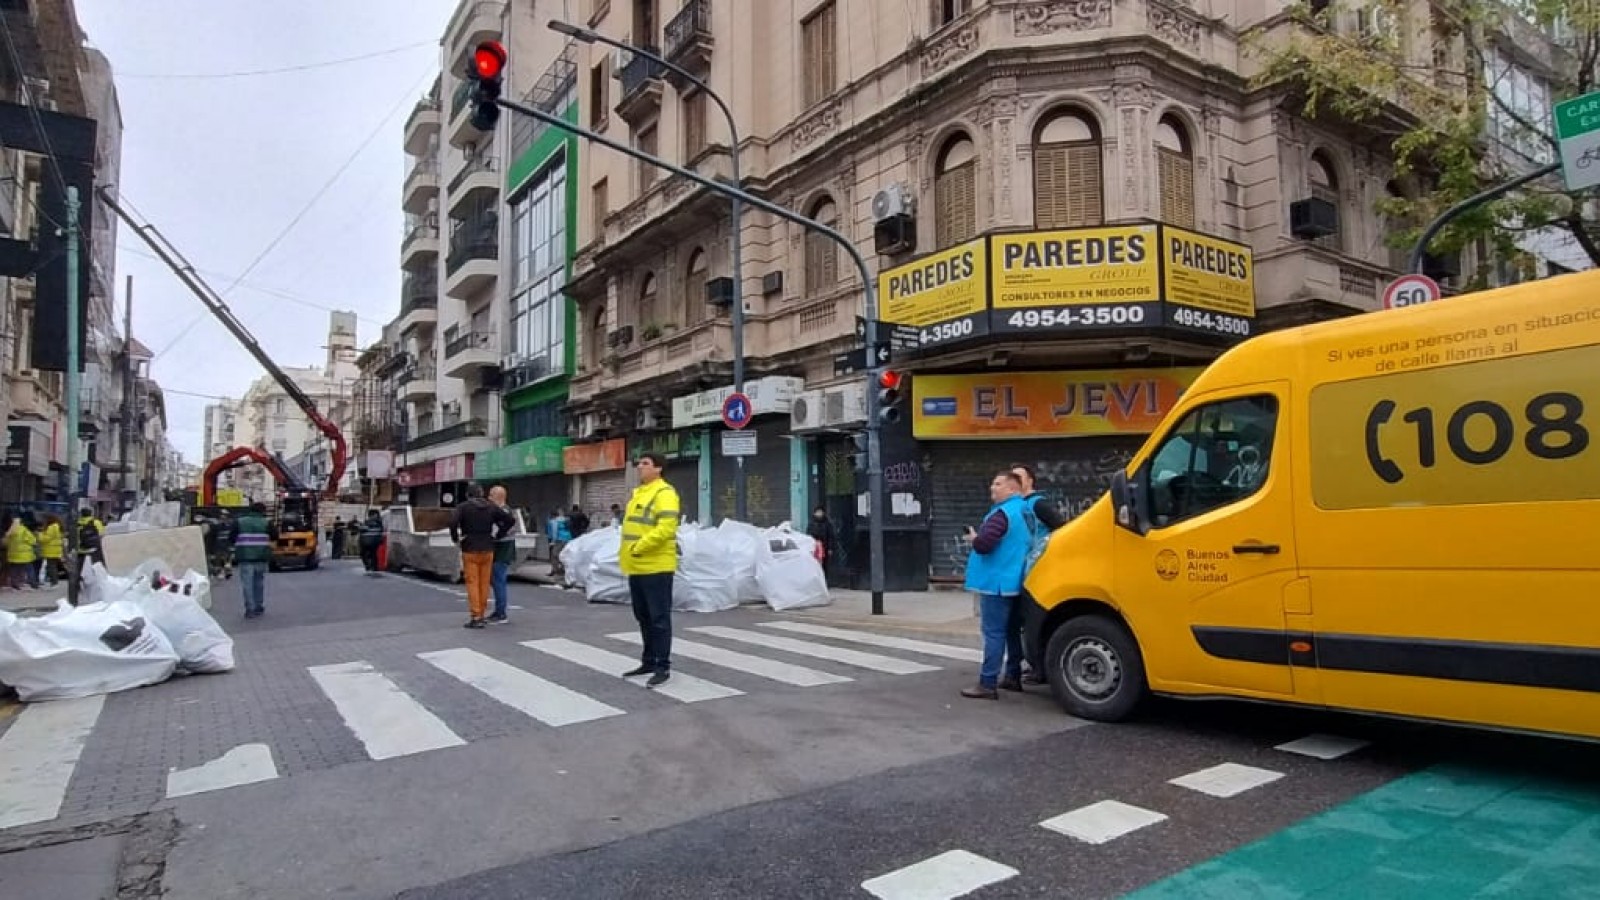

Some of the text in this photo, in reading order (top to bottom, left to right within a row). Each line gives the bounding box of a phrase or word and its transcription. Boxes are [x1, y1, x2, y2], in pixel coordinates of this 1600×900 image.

[1003, 234, 1146, 270] PAREDES
[1171, 237, 1247, 280] PAREDES
[887, 251, 975, 300] PAREDES
[1001, 286, 1151, 302] CONSULTORES EN NEGOCIOS
[1396, 288, 1427, 307] 50
[919, 318, 973, 344] 4-3500
[1008, 305, 1144, 328] 4954-3500
[1173, 307, 1250, 336] 4954-3500
[1328, 349, 1342, 363] Si
[1347, 347, 1375, 359] ves
[1379, 340, 1410, 355] una
[1416, 328, 1488, 351] persona
[1494, 323, 1518, 336] en
[1375, 359, 1396, 372] de
[1401, 351, 1440, 368] calle
[1502, 337, 1518, 353] al
[972, 380, 1162, 424] EL JEVI
[1403, 392, 1590, 468] 108
[1186, 549, 1230, 560] Buenos
[1187, 561, 1217, 571] Aires
[1187, 572, 1228, 582] Ciudad
